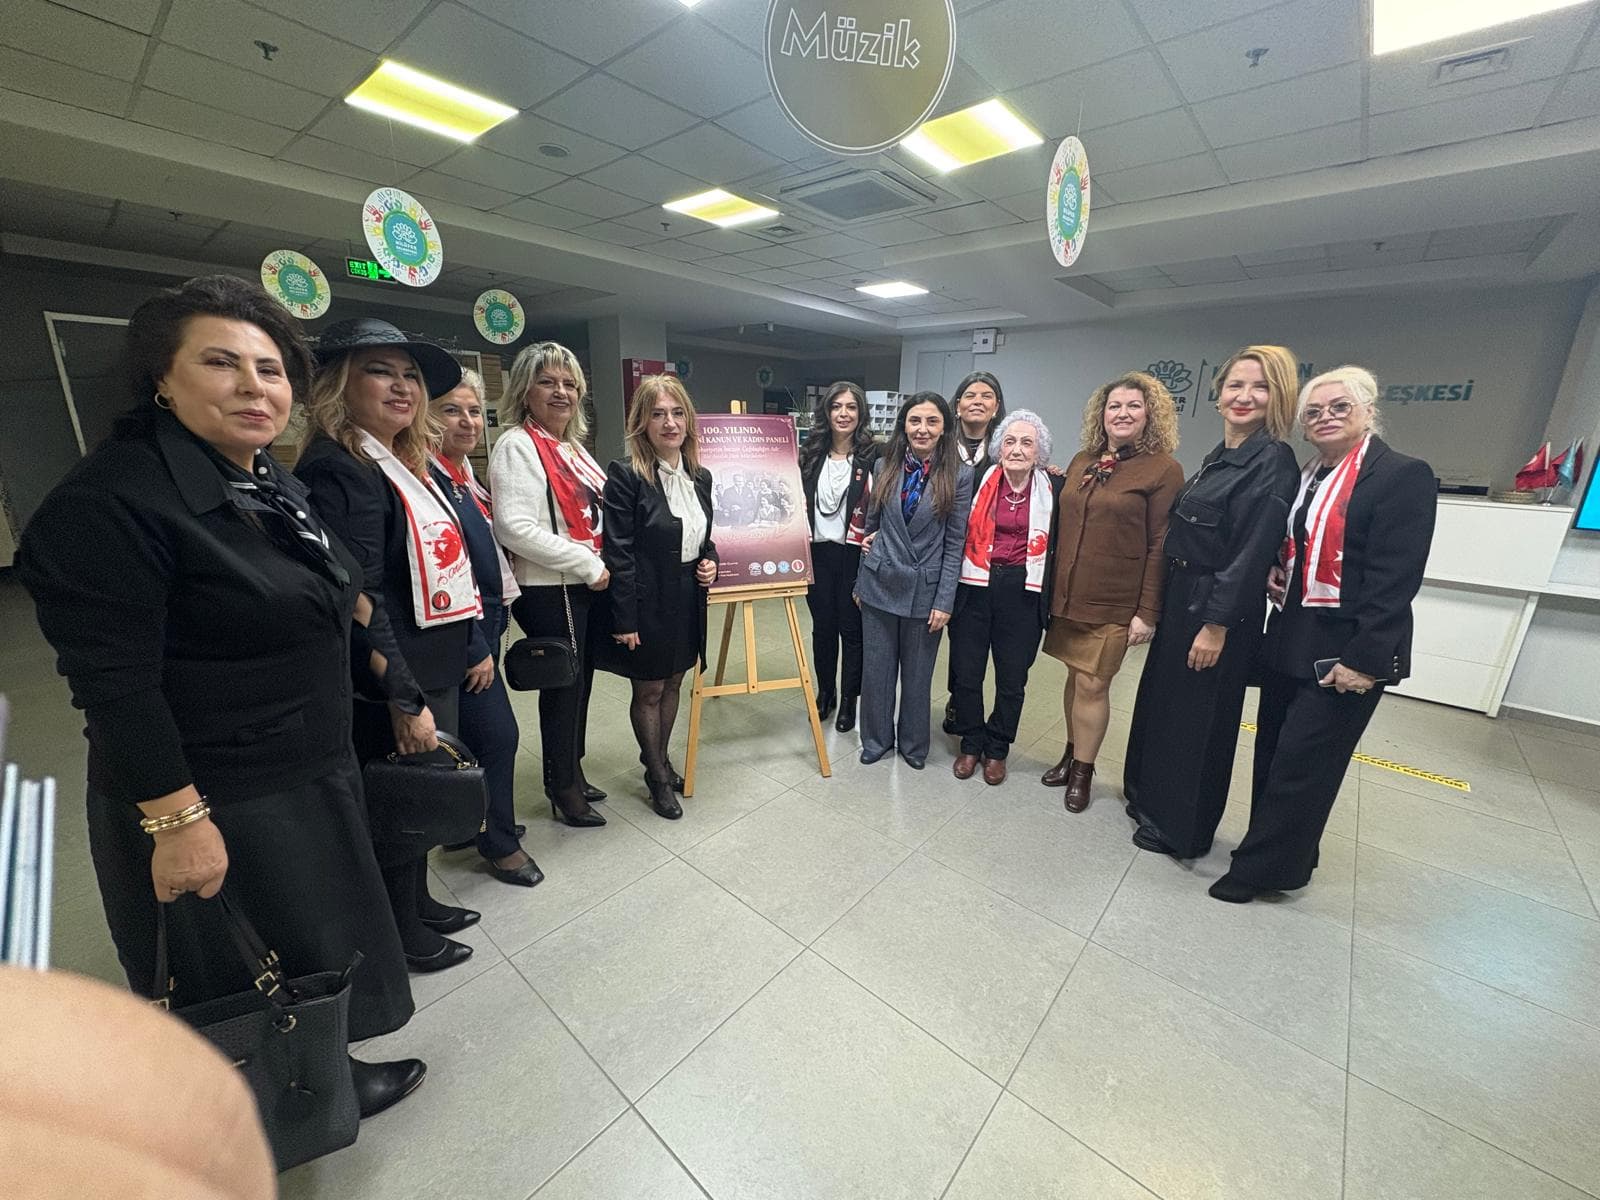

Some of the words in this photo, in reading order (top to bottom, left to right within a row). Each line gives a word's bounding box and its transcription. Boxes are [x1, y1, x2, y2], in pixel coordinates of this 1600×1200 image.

[780, 7, 921, 69] Müzik
[349, 261, 366, 269] EXIT
[1385, 379, 1474, 405] EŞKESİ
[702, 426, 722, 434] 100.
[723, 426, 763, 434] YILINDA
